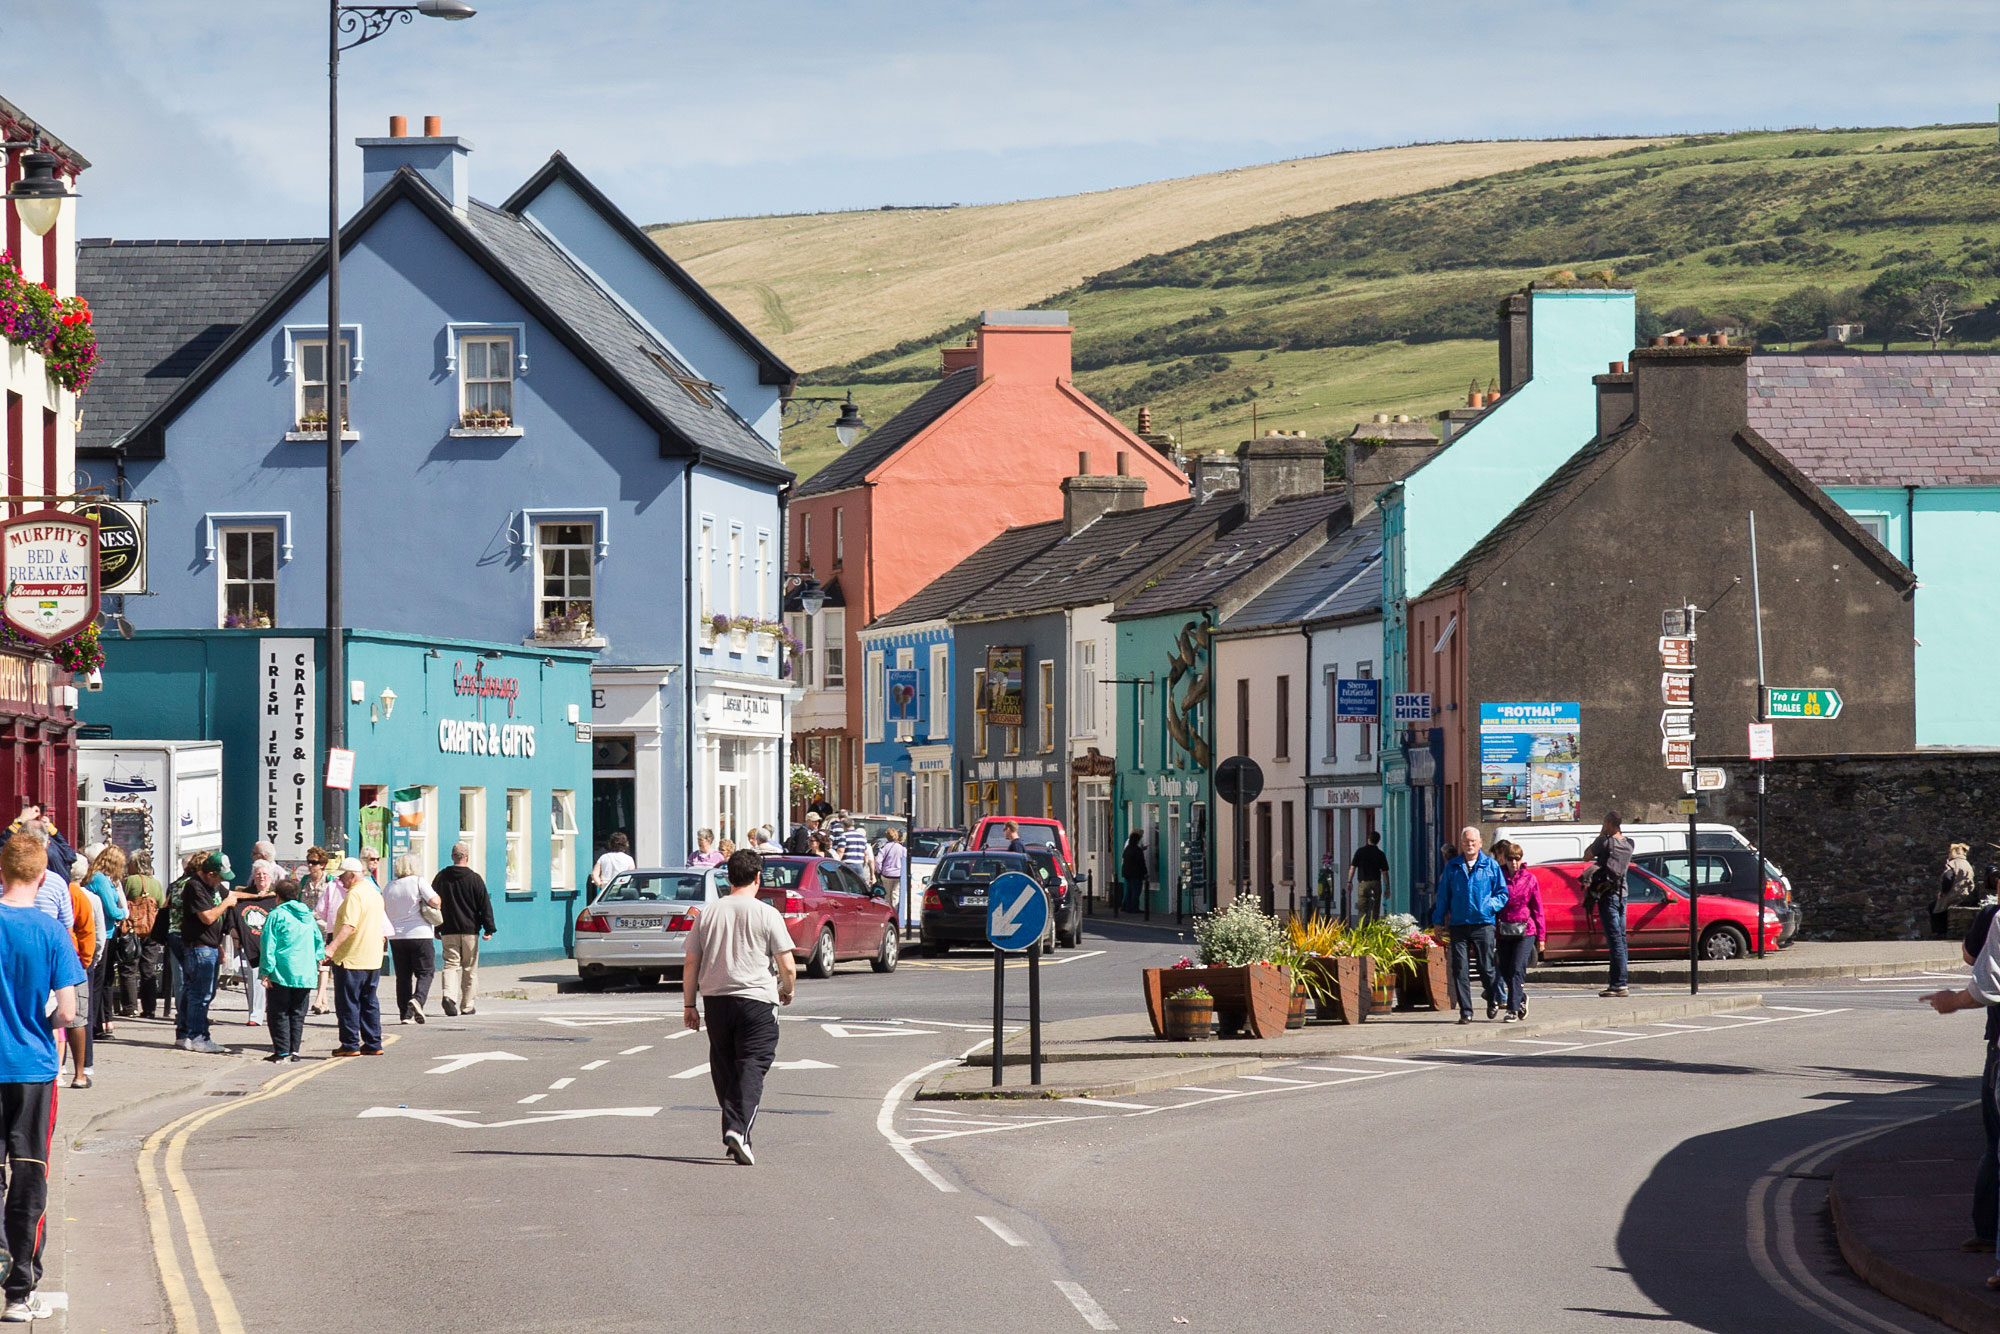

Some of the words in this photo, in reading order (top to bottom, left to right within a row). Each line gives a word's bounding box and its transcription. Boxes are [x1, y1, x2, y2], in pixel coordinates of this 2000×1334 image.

[10, 527, 89, 548] MURPHY'S
[28, 550, 54, 564] BED
[60, 549, 69, 564] &
[10, 566, 88, 581] BREAKFAST
[12, 584, 45, 597] Rooms
[47, 588, 58, 597] en
[60, 584, 86, 597] Suite
[267, 652, 280, 716] IRISH
[1347, 681, 1368, 691] Sherry
[293, 653, 306, 741] CRAFTS
[1395, 695, 1430, 706] BIKE
[1808, 692, 1817, 703] N
[1395, 707, 1430, 719] HIRE
[1773, 703, 1801, 712] TRALEE
[1804, 703, 1821, 715] 86
[439, 718, 487, 754] CRAFTS
[488, 722, 500, 757] &
[501, 723, 536, 759] GIFTS
[293, 746, 306, 760] &
[265, 730, 281, 845] JEWELLERY
[293, 772, 306, 845] GIFTS
